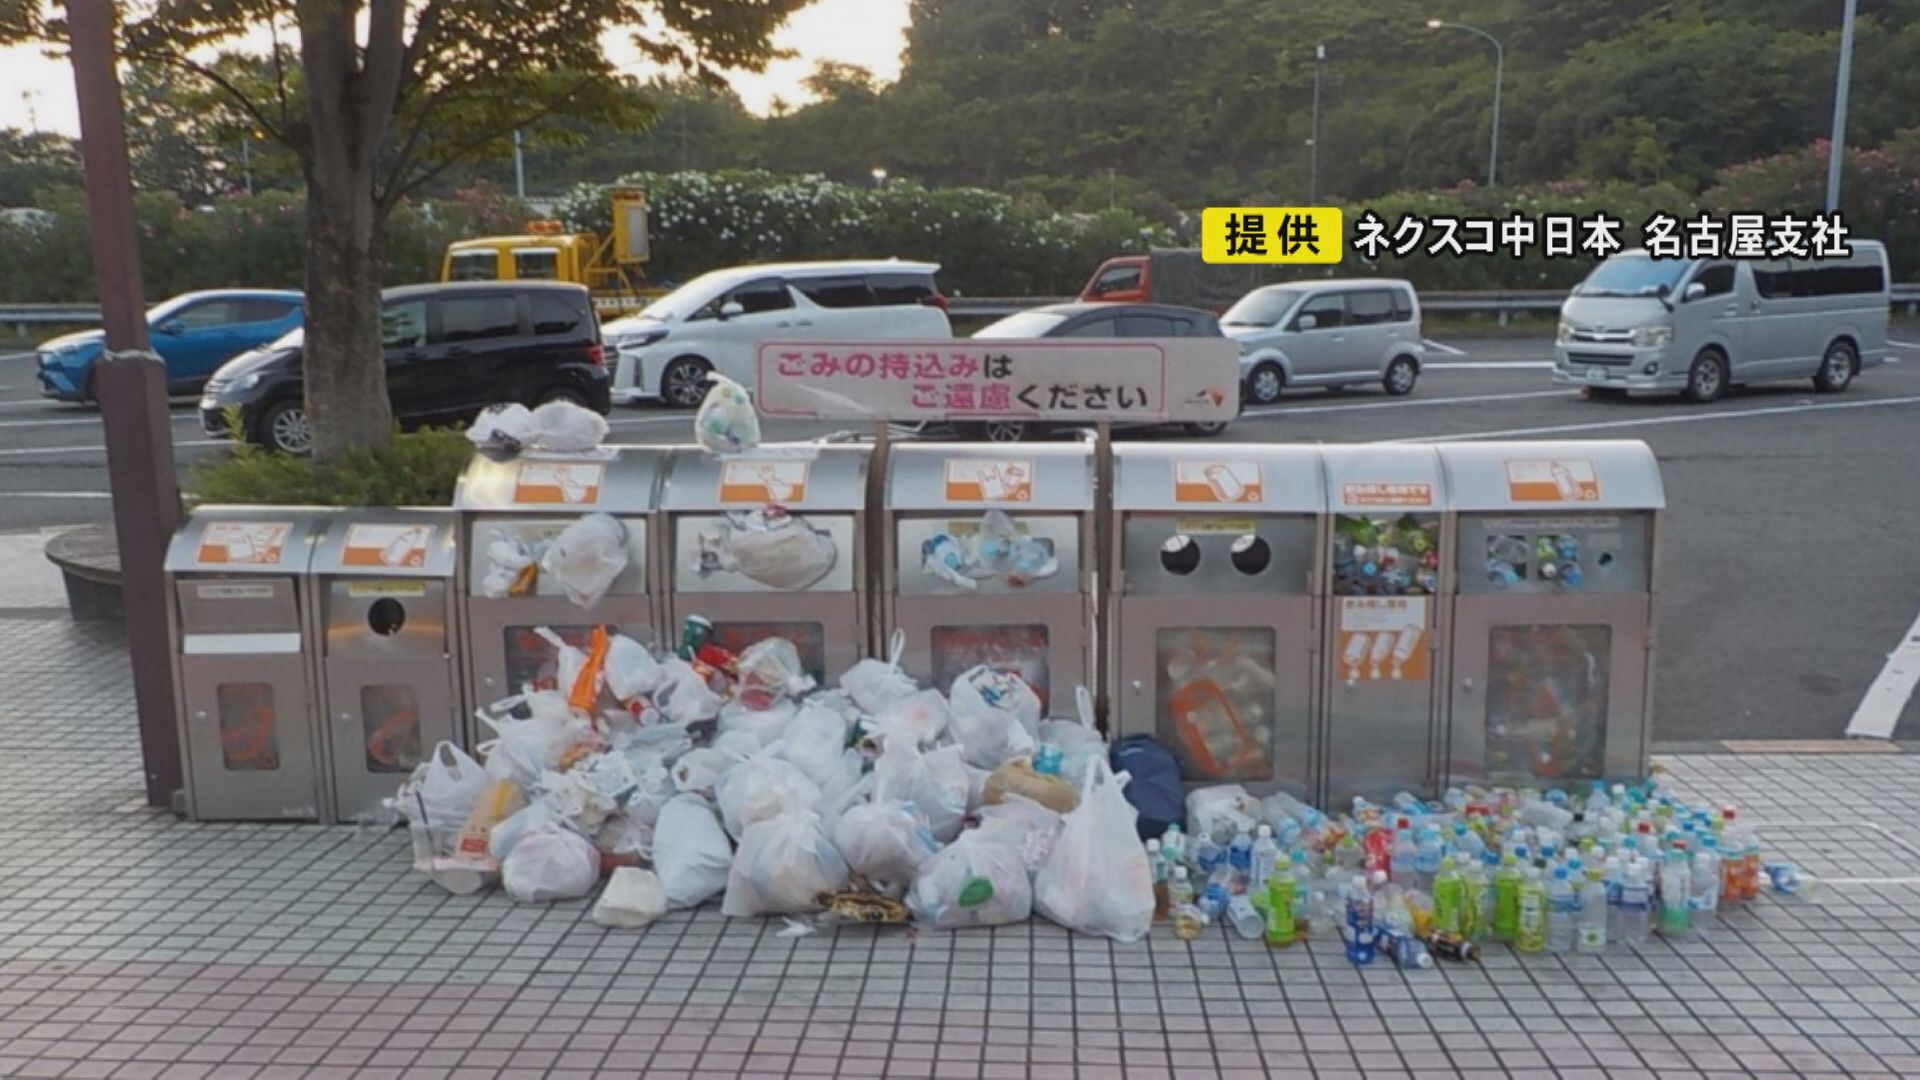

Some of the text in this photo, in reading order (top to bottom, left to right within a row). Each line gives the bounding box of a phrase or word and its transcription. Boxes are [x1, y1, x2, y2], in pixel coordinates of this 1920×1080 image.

[777, 352, 1012, 378] ごみの持込みは
[911, 384, 1147, 411] ご遠慮ください
